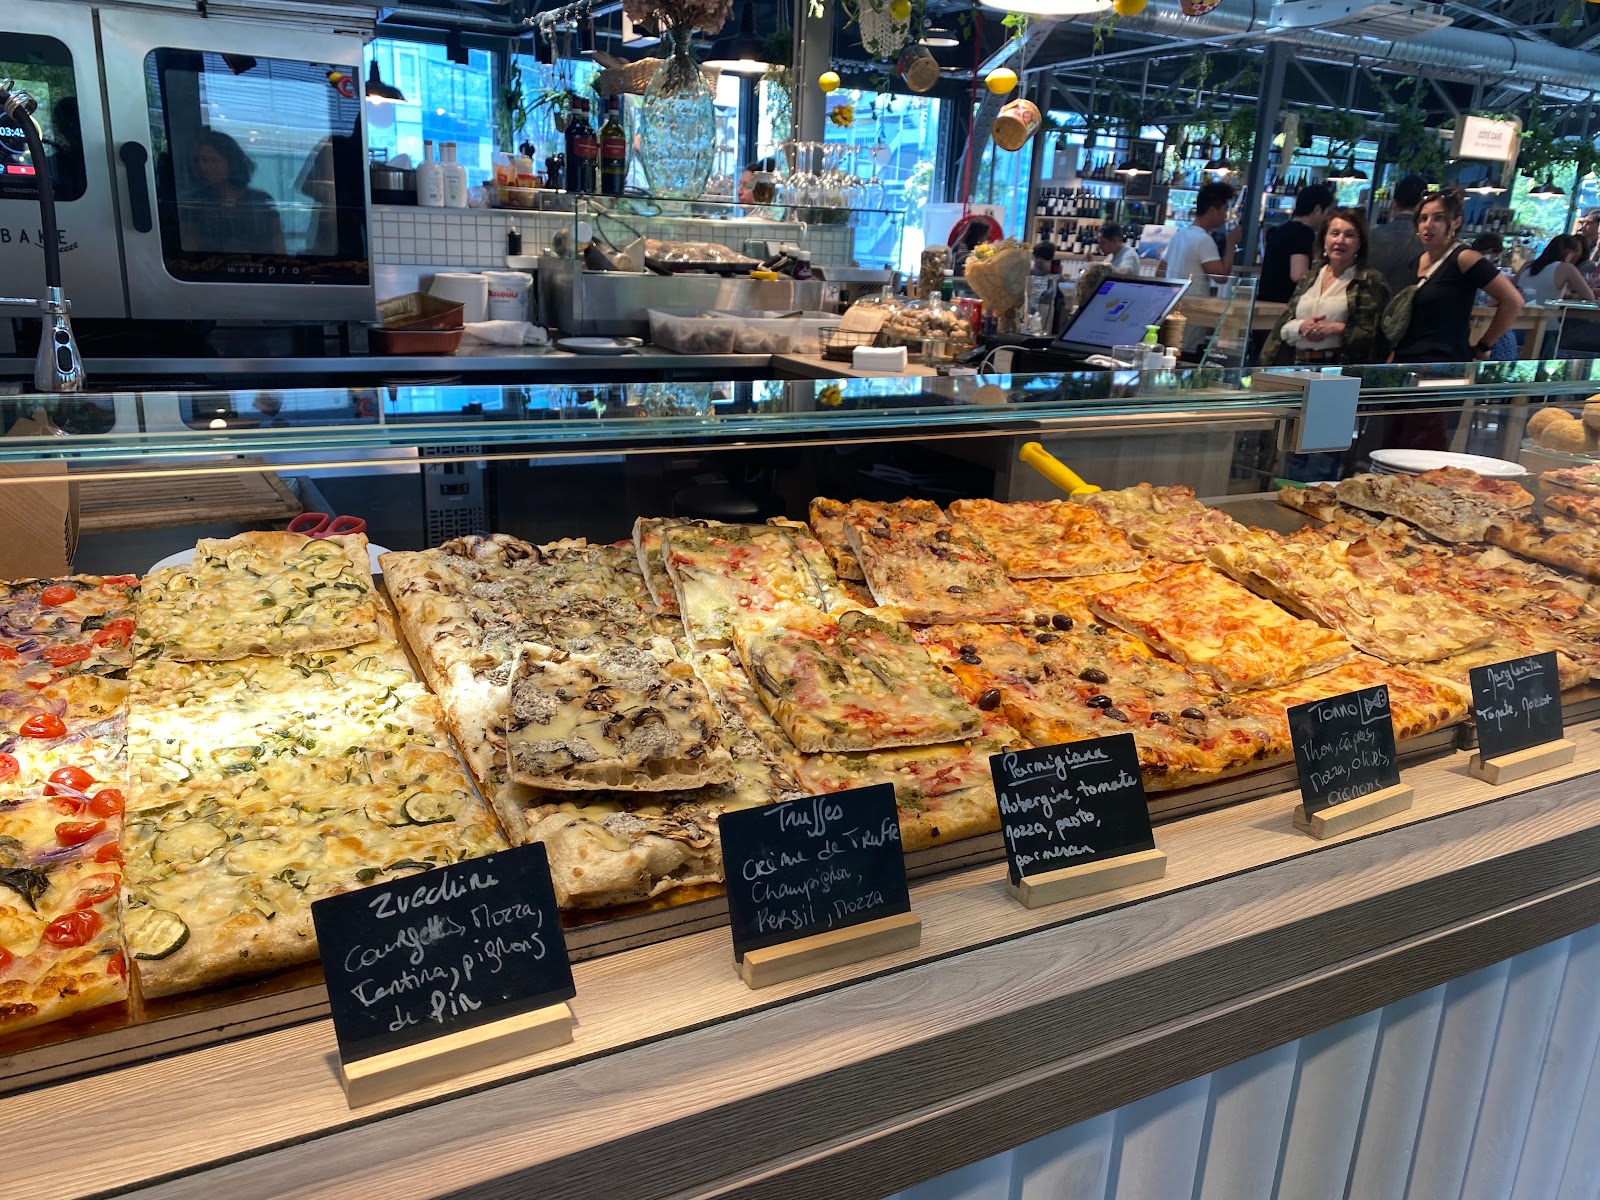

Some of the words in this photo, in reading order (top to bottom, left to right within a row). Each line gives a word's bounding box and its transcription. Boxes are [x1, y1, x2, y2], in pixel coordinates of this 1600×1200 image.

[1307, 702, 1358, 723] Tonno
[1003, 747, 1110, 783] Parmigiana
[1076, 769, 1138, 798] tomate
[818, 839, 846, 860] de
[1014, 845, 1096, 878] parmesan
[369, 858, 500, 919] Zucchini
[389, 1005, 419, 1032] de
[430, 990, 482, 1024] Pin
